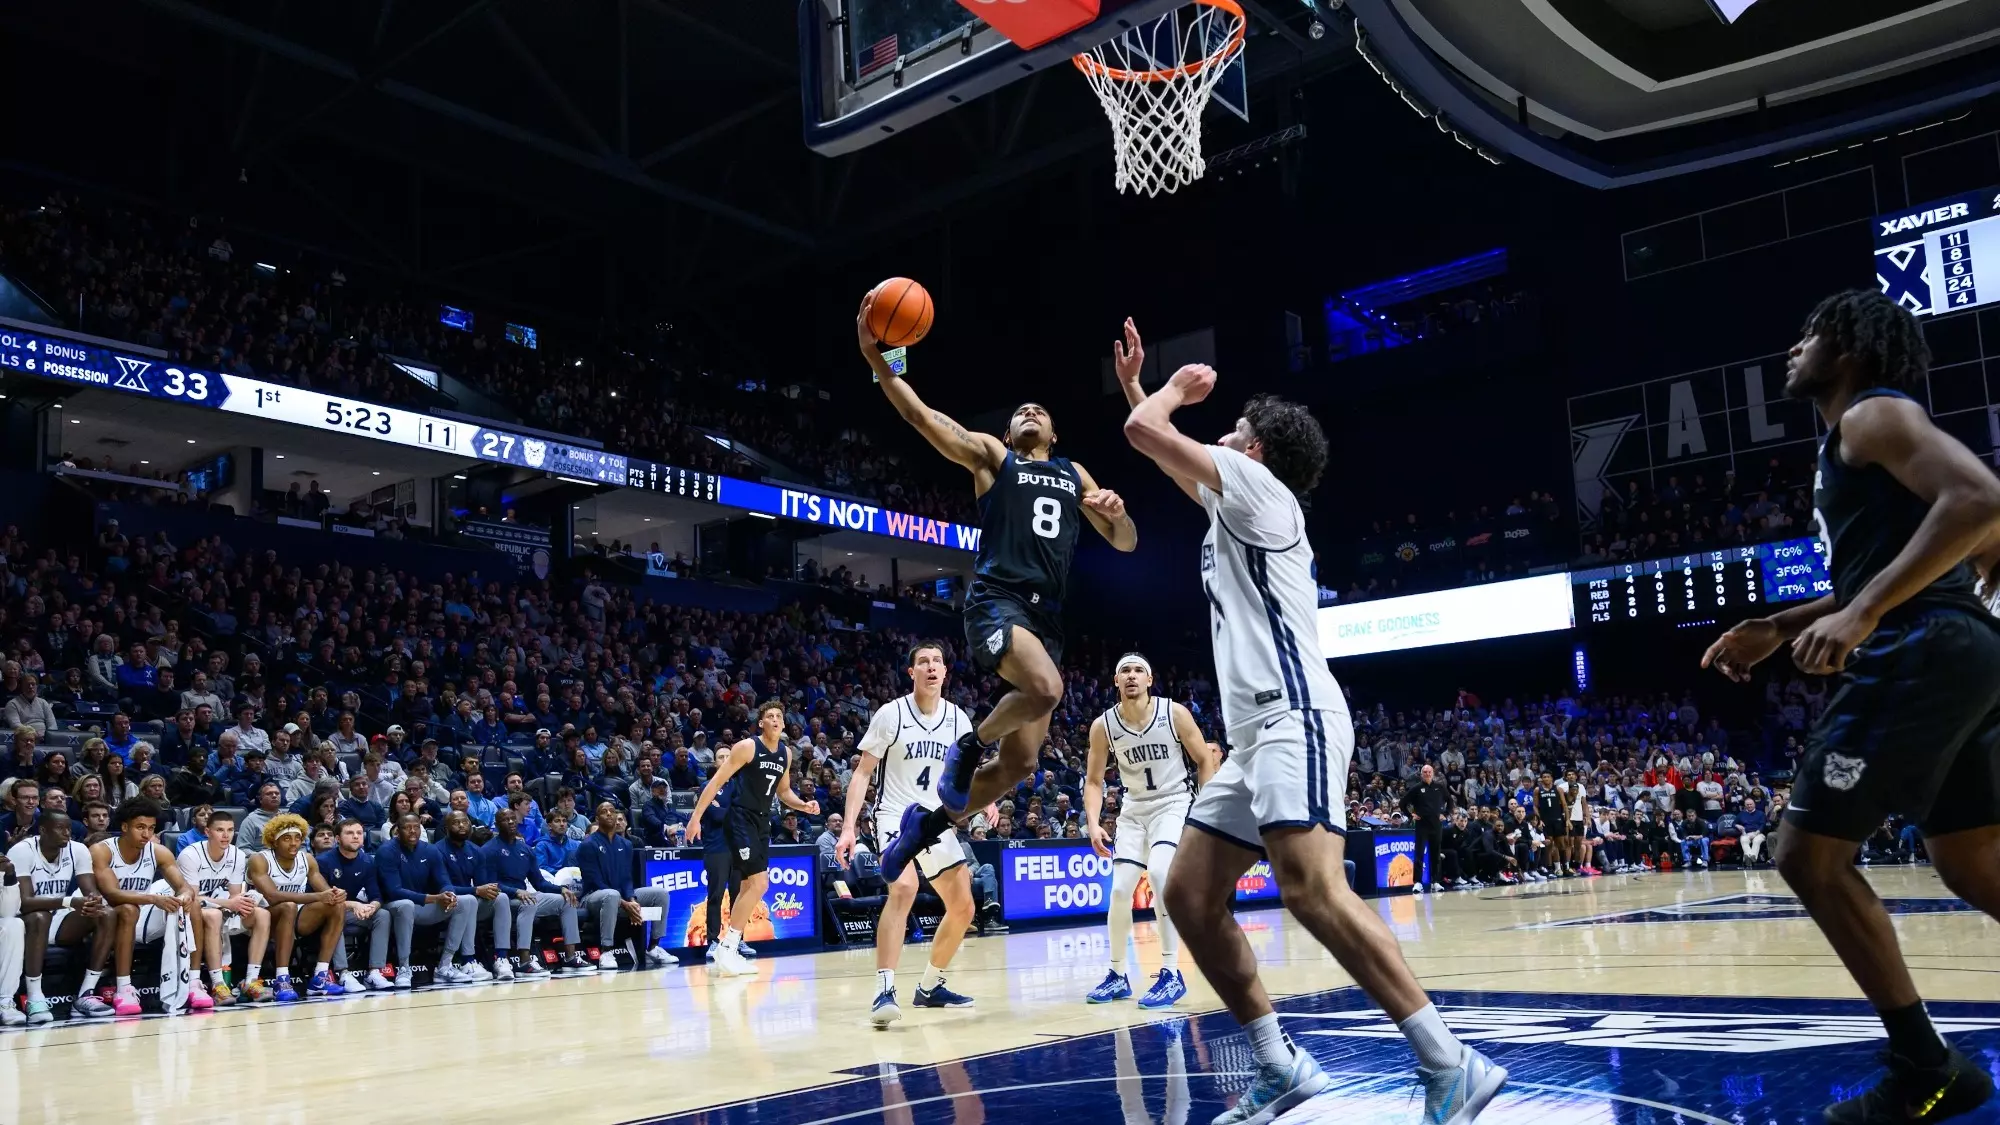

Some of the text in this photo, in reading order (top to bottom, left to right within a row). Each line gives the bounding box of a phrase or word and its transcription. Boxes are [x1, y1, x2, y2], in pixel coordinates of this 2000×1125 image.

[1880, 202, 1969, 236] XAVIER
[1947, 232, 1961, 246] 11
[1950, 248, 1963, 260] 8
[1952, 262, 1964, 275] 6
[1948, 276, 1972, 292] 24
[1956, 291, 1968, 304] 4
[0, 334, 37, 351] OL 4
[45, 343, 86, 361] BONUS
[0, 353, 36, 370] LS 6
[43, 361, 109, 384] POSSESSION
[162, 368, 208, 400] 33
[255, 388, 281, 408] 1st
[325, 401, 392, 435] 5:23
[481, 432, 515, 459] 27
[569, 450, 625, 469] BONUS 4 TOL
[553, 461, 624, 483] POSSESSION 4 FLS
[629, 468, 713, 492] PTS 11 4 3 3 0
[651, 464, 656, 472] 5
[680, 470, 686, 478] 8
[707, 475, 715, 483] 13
[629, 478, 713, 500] FLS 1 2 0 0 0
[1017, 472, 1076, 496] BUTLER
[781, 489, 821, 522] IT'S
[828, 499, 879, 532] NOT
[885, 510, 950, 546] WHAT
[1032, 496, 1062, 539] 8
[494, 542, 531, 555] REPUBLIC
[1683, 557, 1690, 565] 4
[1712, 552, 1722, 561] 12
[1741, 547, 1755, 556] 24
[1774, 547, 1802, 559] FG%
[1590, 558, 1752, 590] PTS 4 4 6 10 7
[1776, 564, 1812, 578] 3FG%
[1590, 569, 1754, 600] REB 4 0 4 5 0
[1778, 583, 1806, 596] FT%
[1592, 581, 1755, 611] AST 2 2 3 0 2
[1592, 592, 1757, 622] FLS 0 0 2 0 0
[1338, 612, 1440, 638] CRAVE GOODNESS
[1123, 743, 1169, 765] XAVIER
[759, 761, 784, 774] BUTLER
[916, 765, 931, 791] 4
[765, 774, 777, 796] 7
[1144, 767, 1157, 791] 1
[1375, 843, 1390, 857] FEEL
[1390, 841, 1410, 853] GOOD
[1014, 855, 1066, 881] FEEL
[650, 870, 699, 892] FEEL
[1044, 882, 1103, 910] FOOD
[844, 920, 872, 931] FENIX
